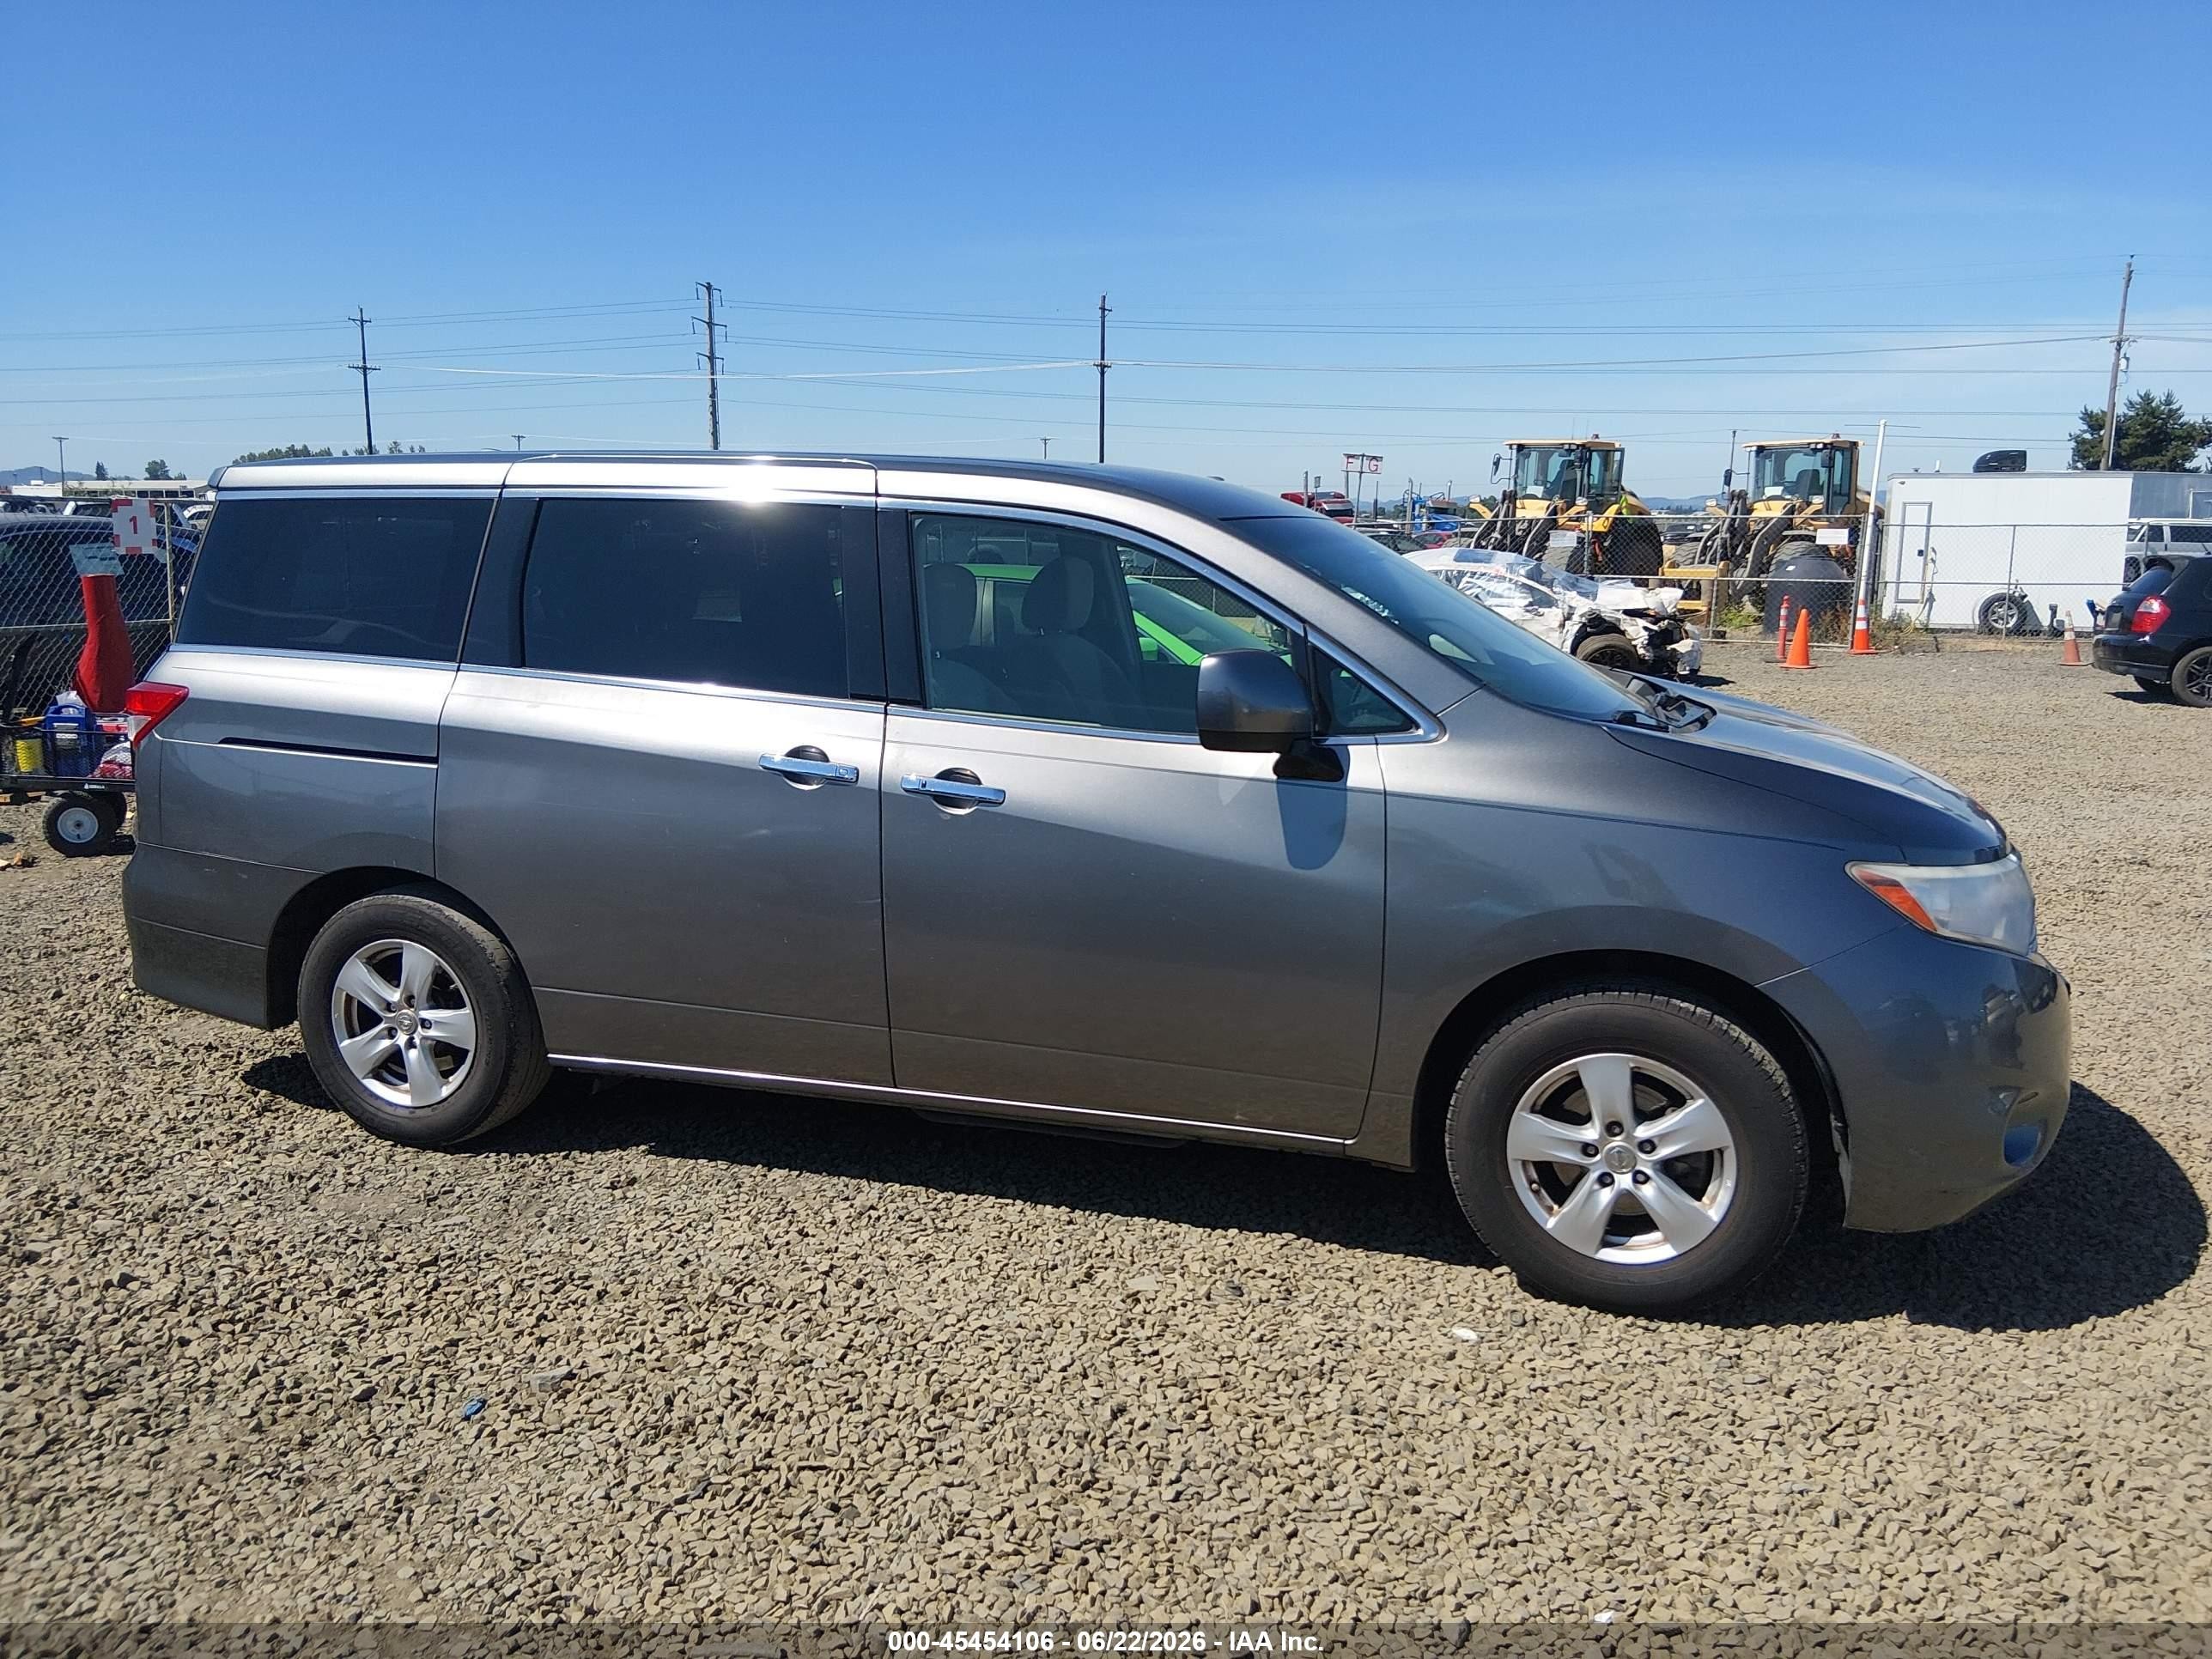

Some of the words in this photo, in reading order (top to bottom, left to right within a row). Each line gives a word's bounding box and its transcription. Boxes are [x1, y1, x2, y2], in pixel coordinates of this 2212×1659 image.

[1346, 456, 1355, 470] F
[1369, 458, 1379, 472] G
[129, 515, 138, 534] 1
